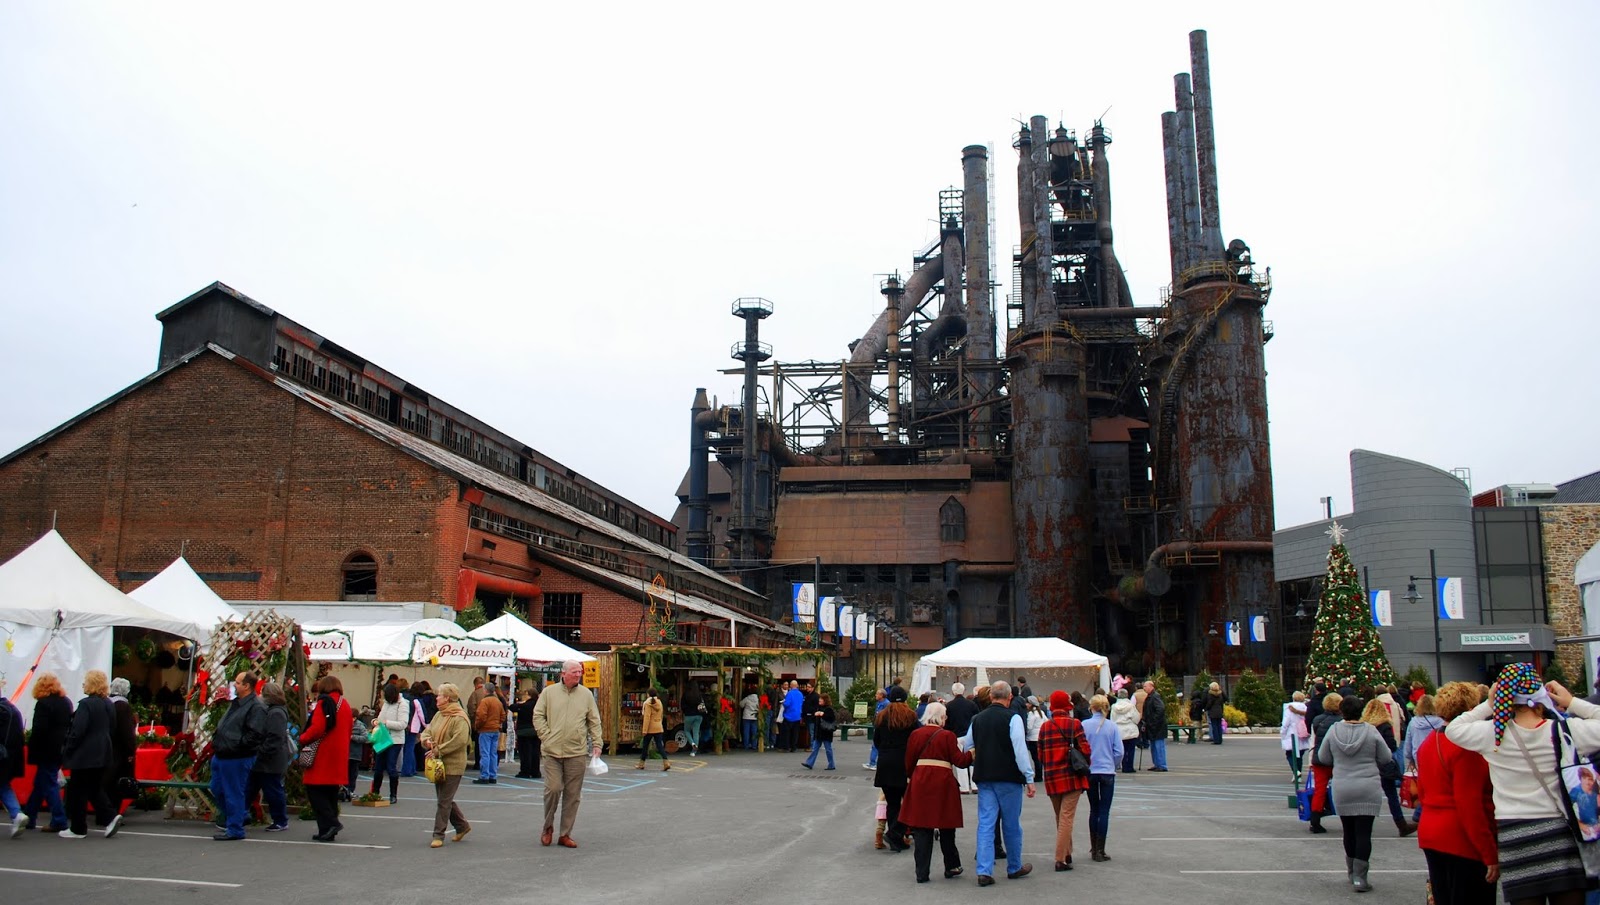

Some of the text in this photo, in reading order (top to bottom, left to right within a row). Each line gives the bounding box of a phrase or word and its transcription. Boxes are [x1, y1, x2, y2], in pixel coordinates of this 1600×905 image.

[305, 637, 345, 650] urri
[1464, 634, 1514, 642] RESTROOMS
[421, 642, 510, 660] Fresh Potpourri
